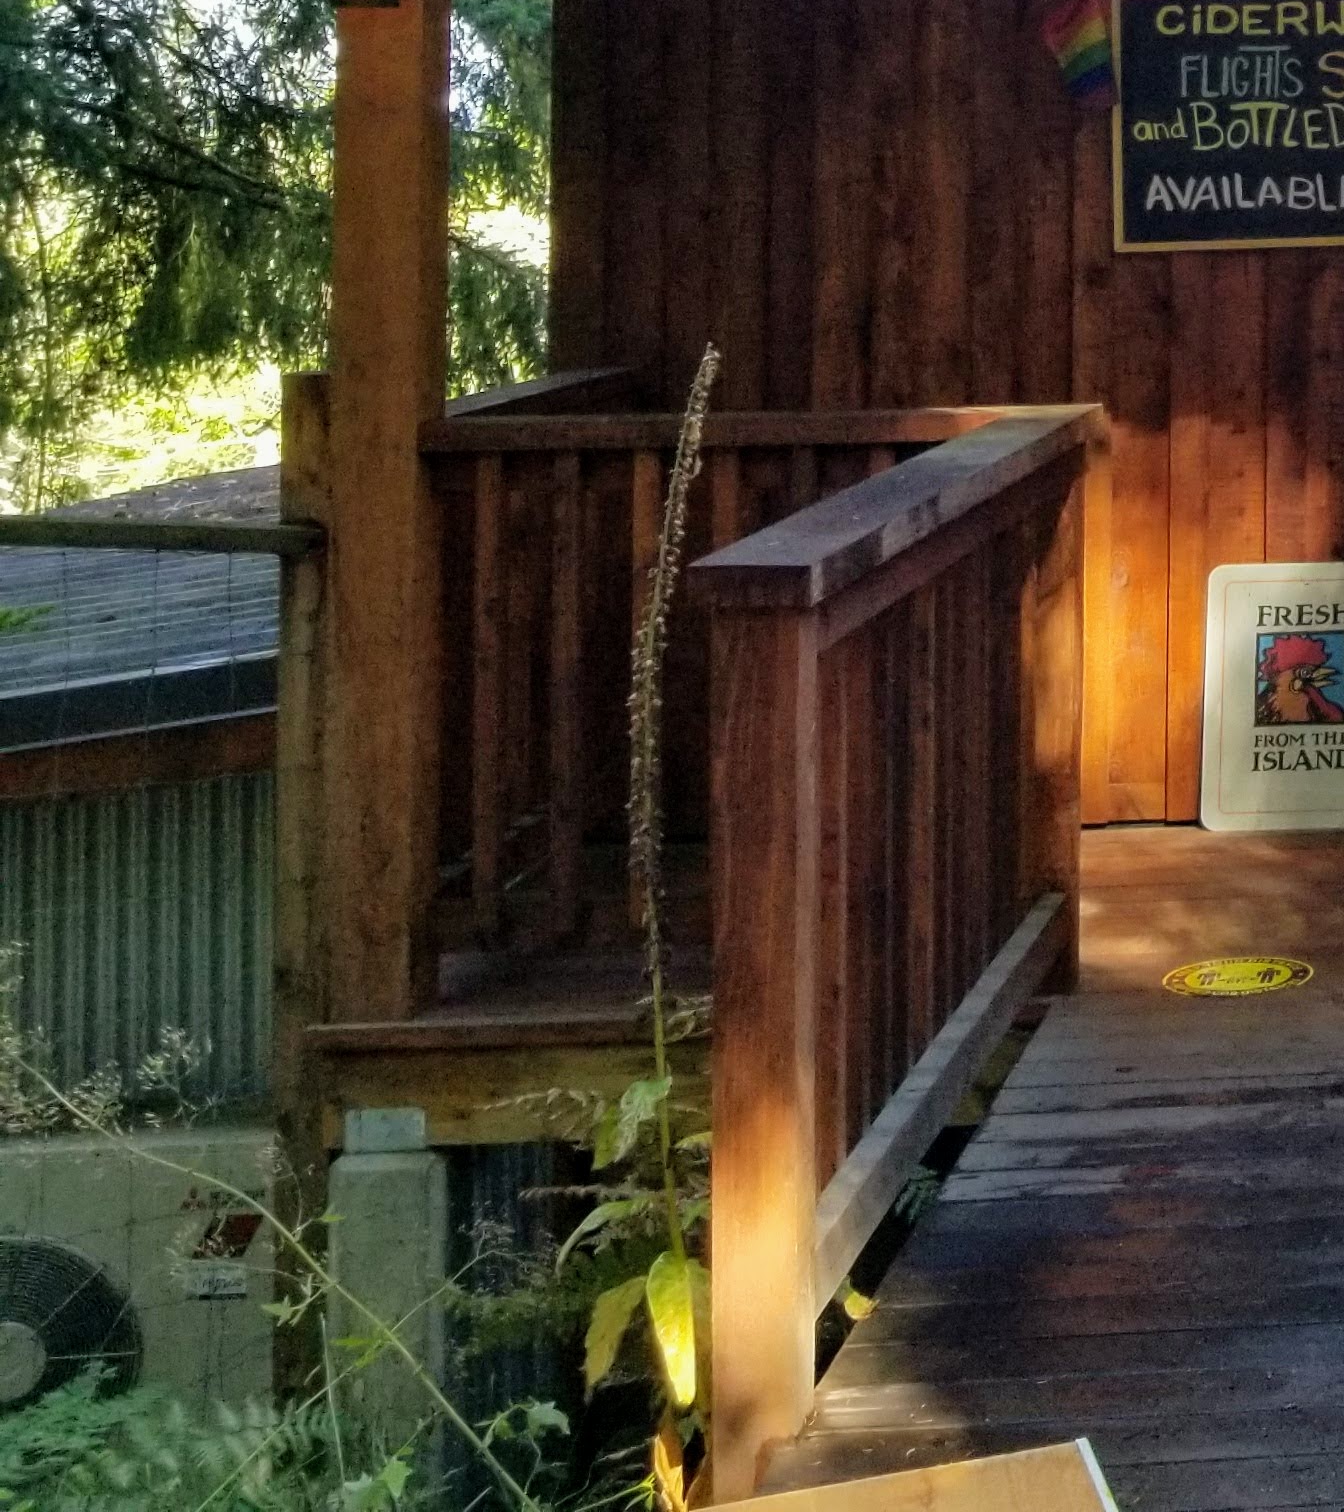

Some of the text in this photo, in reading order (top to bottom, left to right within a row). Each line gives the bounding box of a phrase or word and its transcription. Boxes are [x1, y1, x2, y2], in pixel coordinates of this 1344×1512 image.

[1180, 45, 1304, 99] FLIGHTS
[1133, 108, 1188, 142] and
[1254, 733, 1305, 748] FROM
